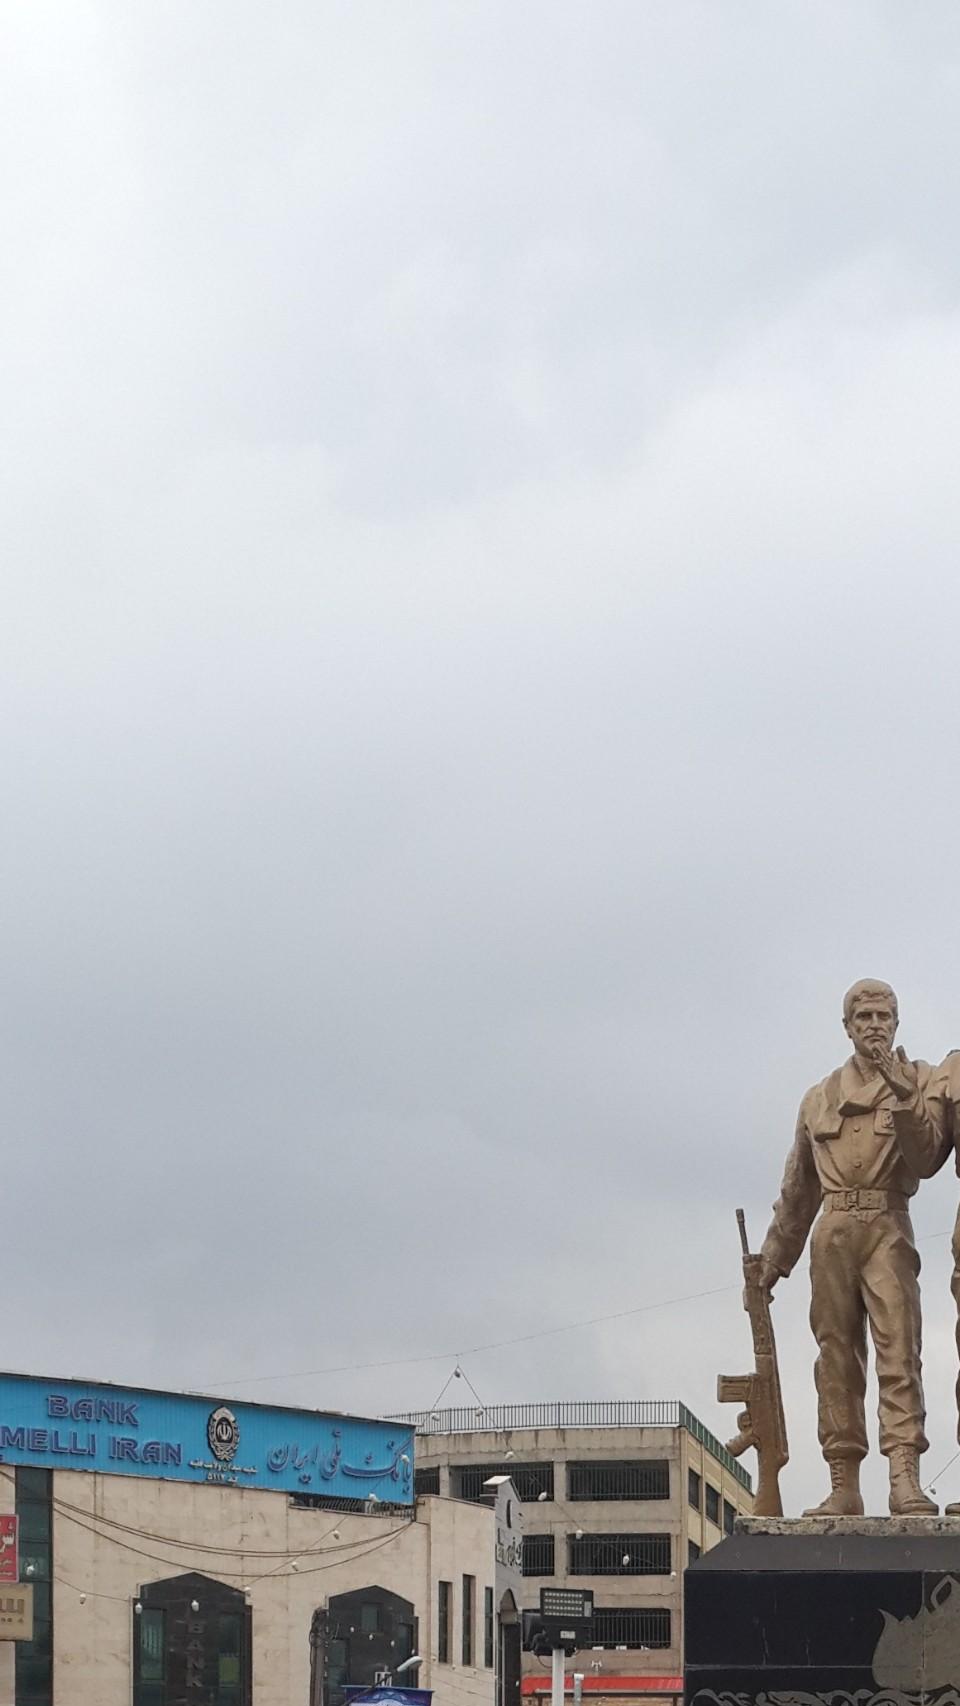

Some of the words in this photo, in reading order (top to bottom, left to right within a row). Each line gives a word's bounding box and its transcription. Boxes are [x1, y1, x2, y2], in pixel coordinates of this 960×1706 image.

[47, 1394, 139, 1426] BANK
[0, 1426, 96, 1456] MELLI
[108, 1435, 182, 1465] IRAN
[267, 1443, 319, 1484] ایران
[342, 1430, 415, 1494] بانک
